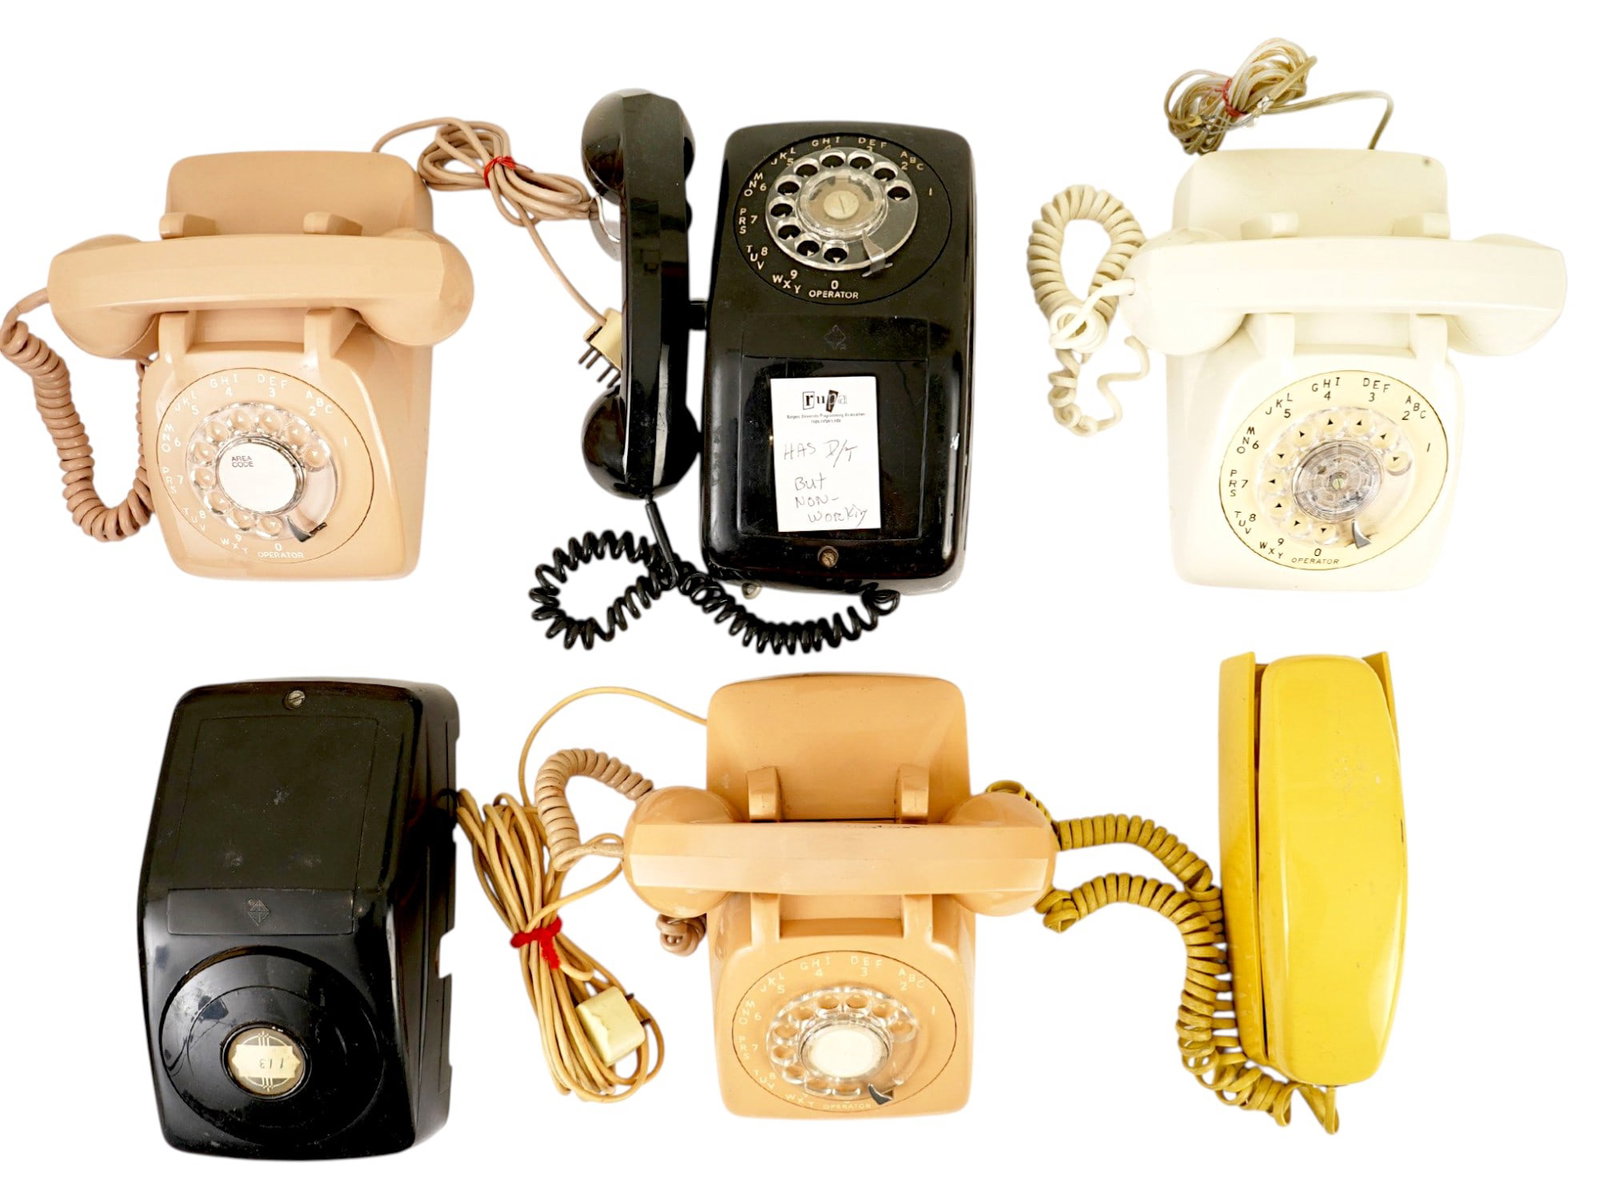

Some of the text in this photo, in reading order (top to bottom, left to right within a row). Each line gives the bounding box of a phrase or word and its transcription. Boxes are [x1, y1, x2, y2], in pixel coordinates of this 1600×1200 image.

[901, 161, 909, 170] 2
[759, 183, 767, 192] 6
[928, 187, 933, 197] 1
[750, 215, 758, 224] 7
[761, 246, 768, 257] 8
[790, 269, 798, 280] 9
[831, 280, 839, 290] 0
[808, 289, 859, 299] OPERATOR
[225, 387, 233, 397] 4
[269, 388, 276, 398] 3
[1324, 391, 1331, 401] 4
[1369, 392, 1376, 402] 3
[309, 407, 317, 417] 2
[1283, 408, 1291, 419] 5
[1402, 410, 1410, 421] 2
[1252, 440, 1260, 450] 6
[1426, 442, 1431, 452] 1
[784, 442, 816, 460] HAS
[1241, 479, 1249, 489] 7
[1249, 513, 1257, 522] 8
[1277, 537, 1285, 546] 9
[257, 551, 304, 560] OPERATOR
[1313, 548, 1322, 557] 0
[1291, 557, 1340, 565] OPERATOR
[861, 968, 868, 977] 3
[900, 981, 908, 991] 2
